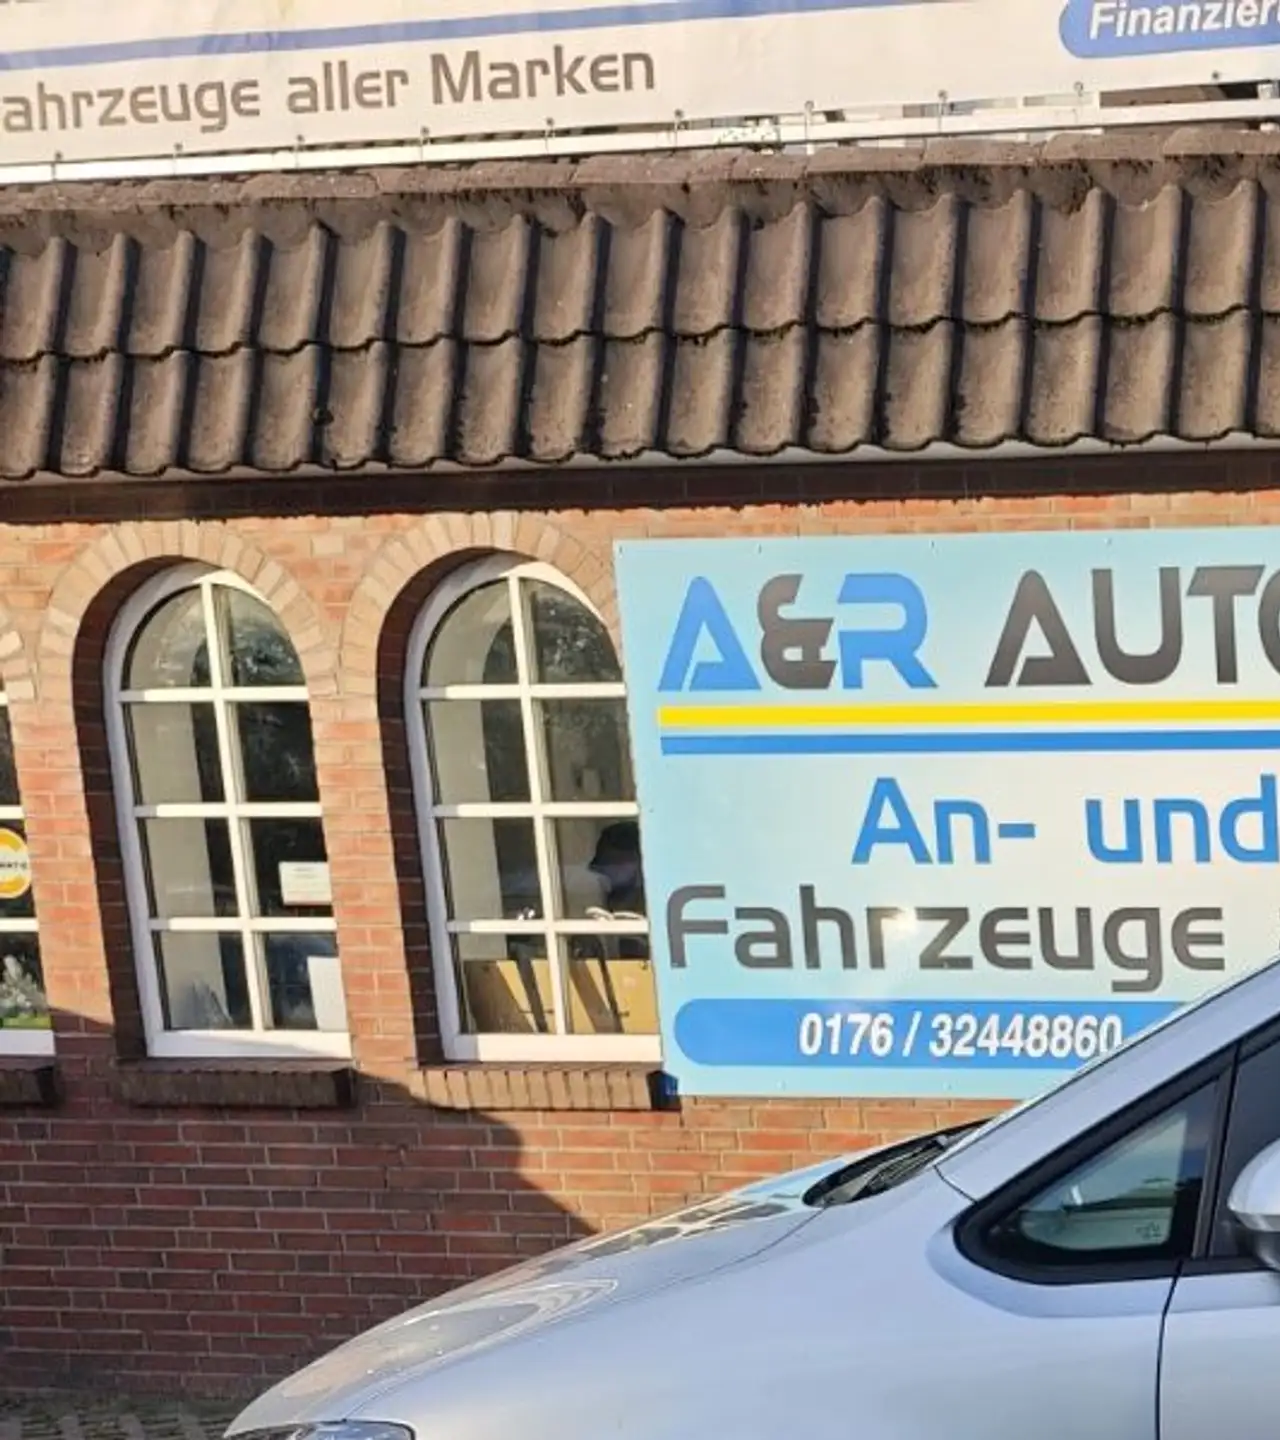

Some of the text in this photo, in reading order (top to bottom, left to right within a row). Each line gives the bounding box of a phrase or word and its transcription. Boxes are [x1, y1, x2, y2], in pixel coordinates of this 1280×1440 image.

[2, 45, 656, 134] ahrzeuge aller Marken
[656, 571, 939, 693] A&R
[850, 775, 1037, 866] An-
[1084, 772, 1280, 865] und
[665, 883, 1227, 993] Fahrzeuge
[799, 1011, 894, 1057] 0176
[902, 1010, 923, 1058] /
[928, 1012, 1124, 1058] 32448860
